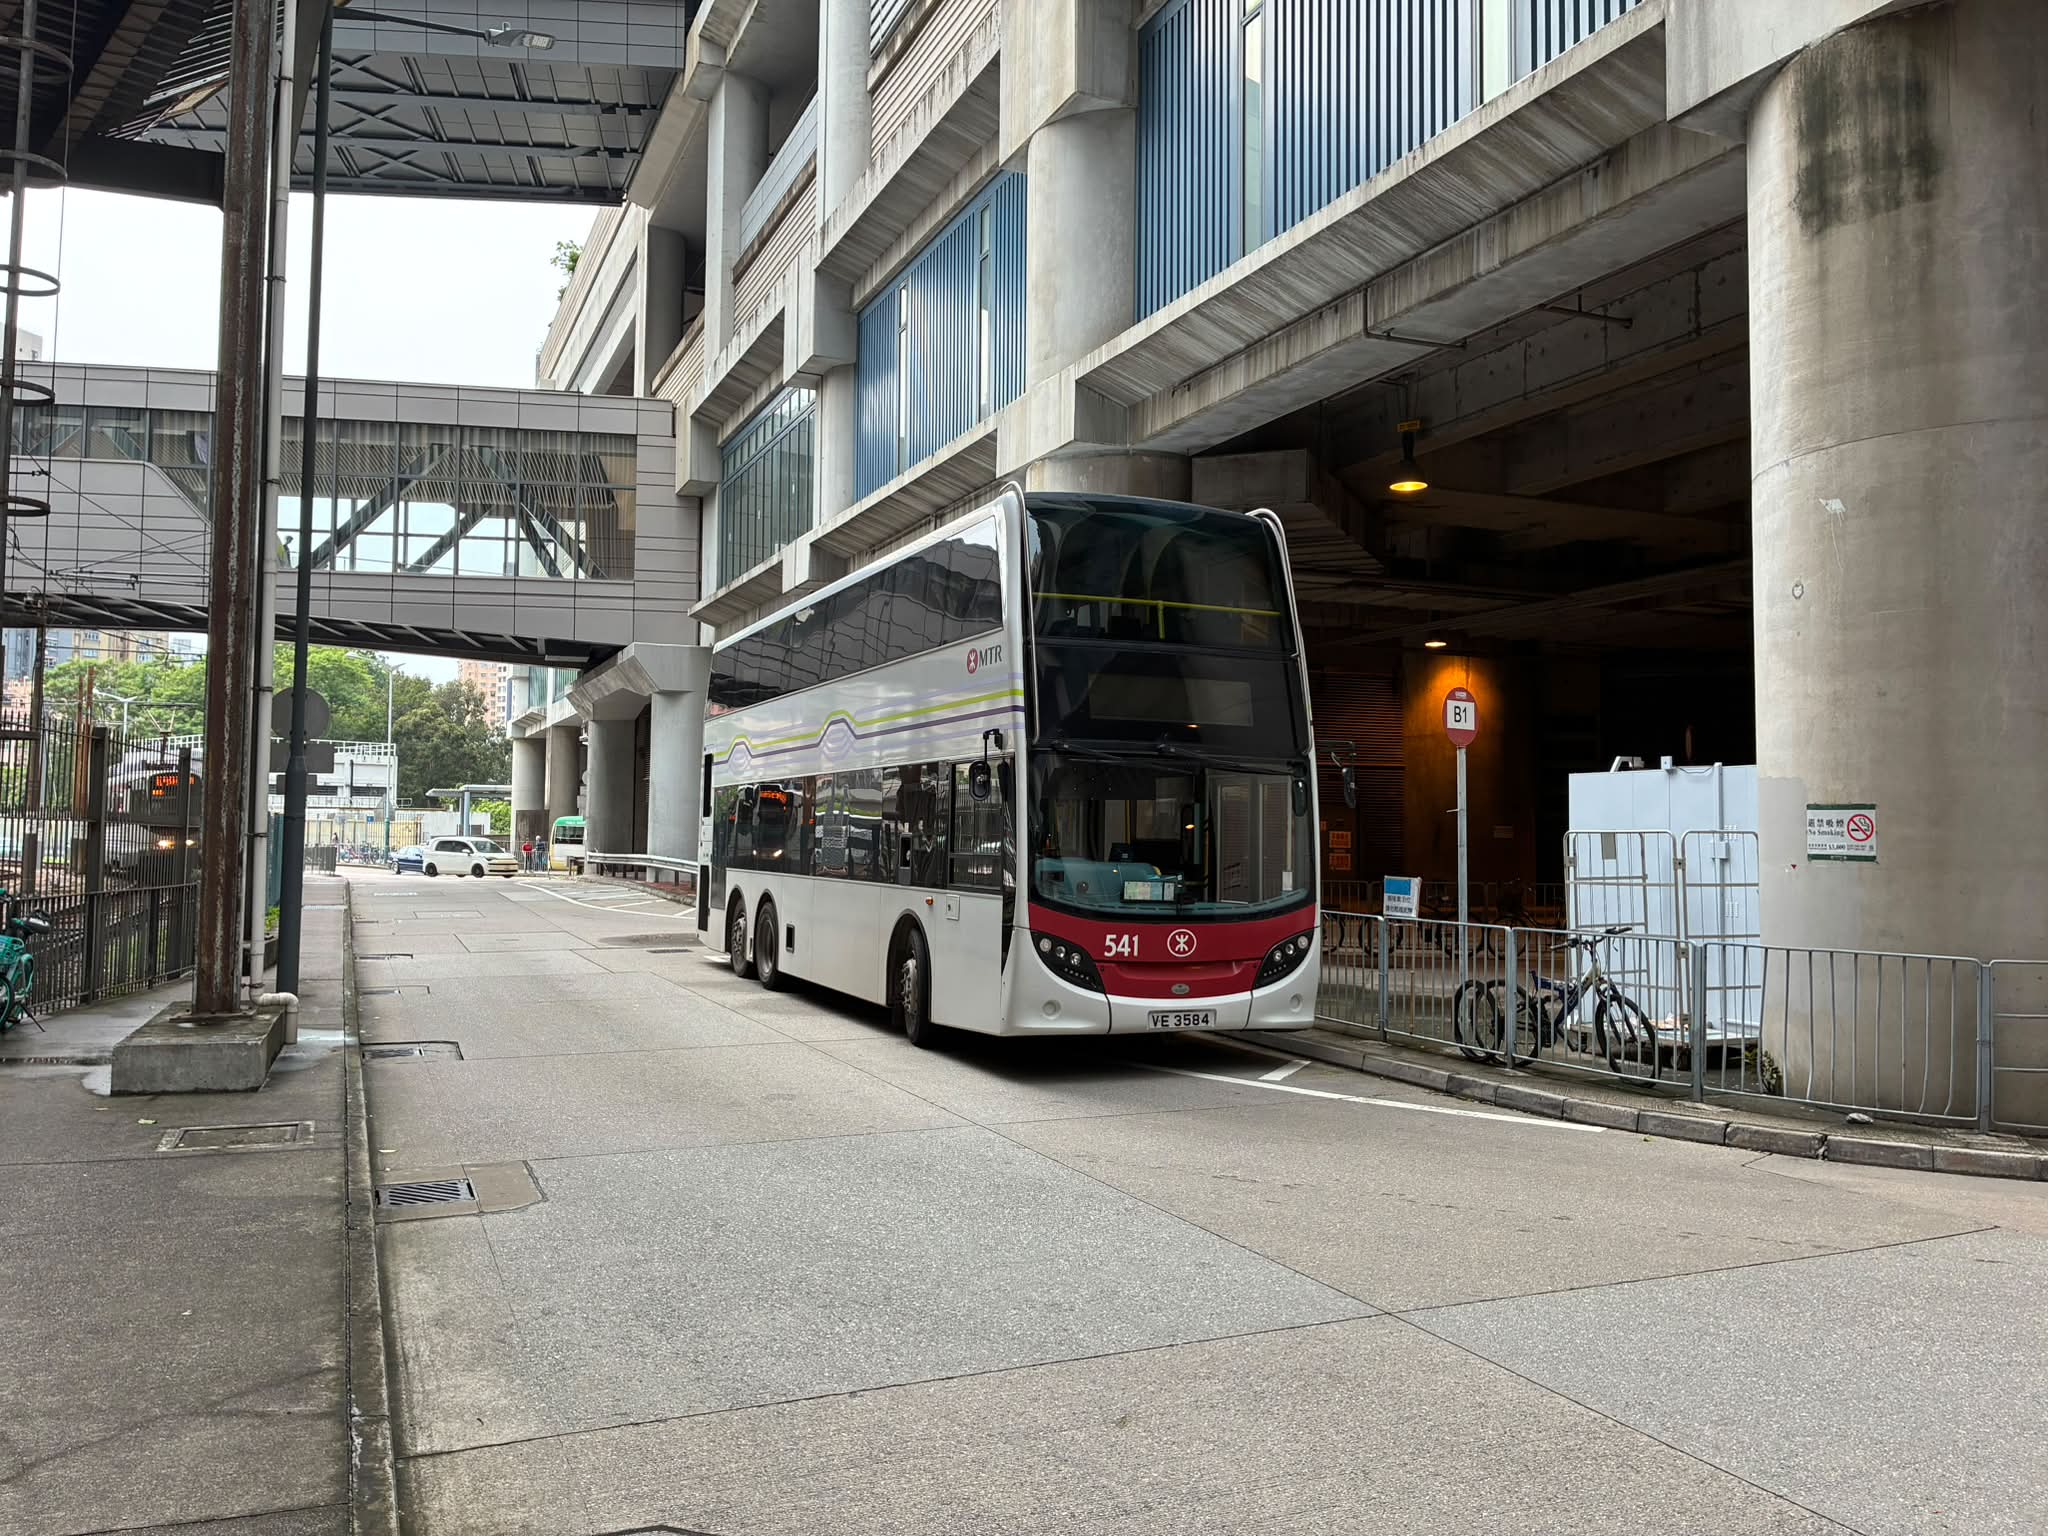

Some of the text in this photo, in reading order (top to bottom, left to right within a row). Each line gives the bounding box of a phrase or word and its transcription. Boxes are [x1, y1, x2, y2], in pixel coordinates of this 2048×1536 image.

[979, 644, 1002, 668] MTR
[1453, 705, 1467, 724] B1
[1817, 829, 1845, 837] Smoking
[1104, 934, 1139, 957] 541
[1151, 1013, 1209, 1027] VE 3584
